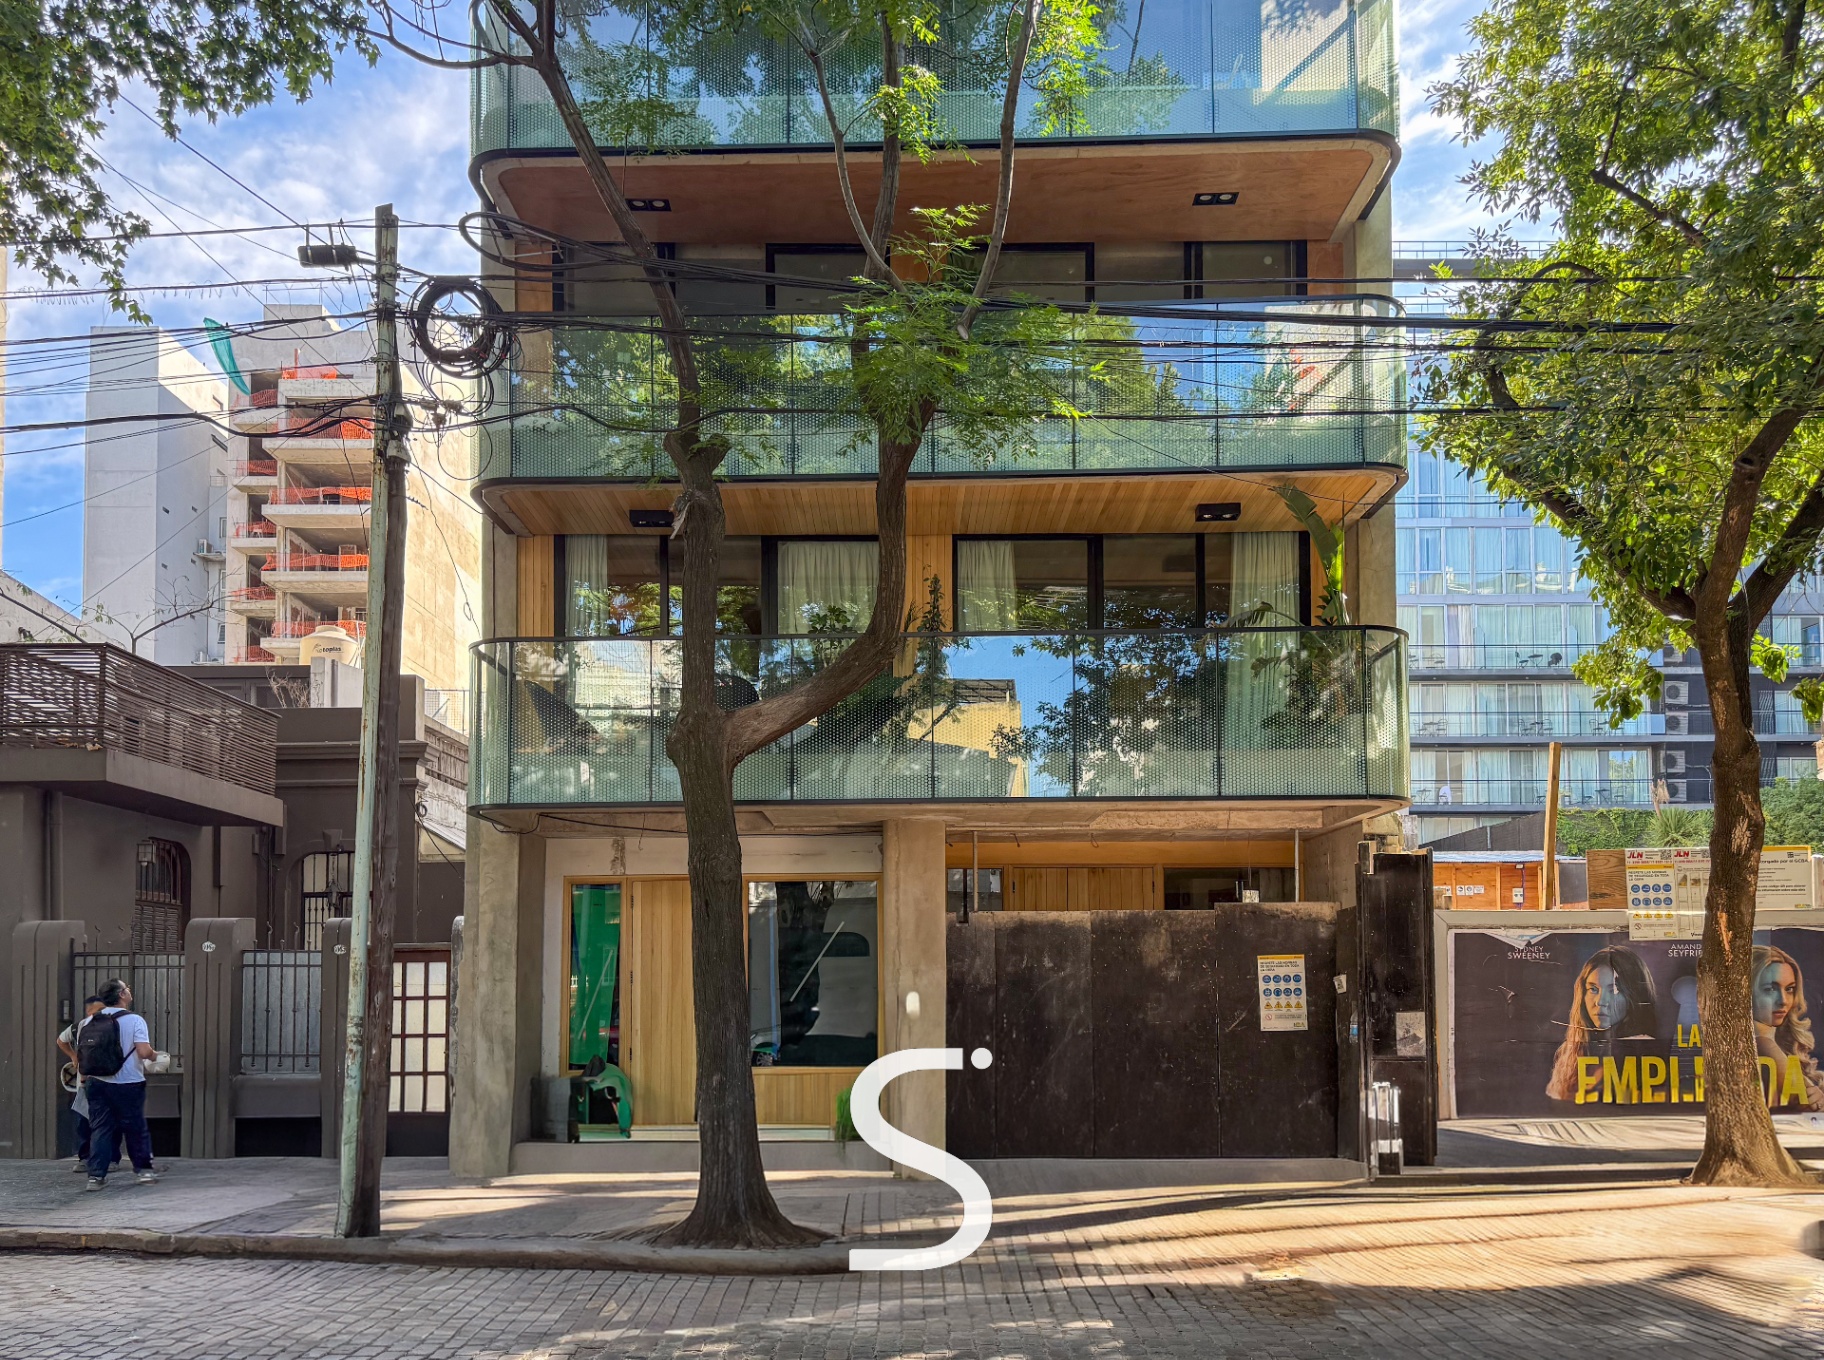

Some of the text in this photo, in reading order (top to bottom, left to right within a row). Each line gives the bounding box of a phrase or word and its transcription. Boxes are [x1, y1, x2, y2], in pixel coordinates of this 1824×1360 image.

[1626, 851, 1644, 859] JLN
[1674, 850, 1690, 858] JLN
[1507, 952, 1551, 960] SWEENEY
[1677, 1024, 1702, 1048] LA
[1575, 1054, 1810, 1105] EMPLDA
